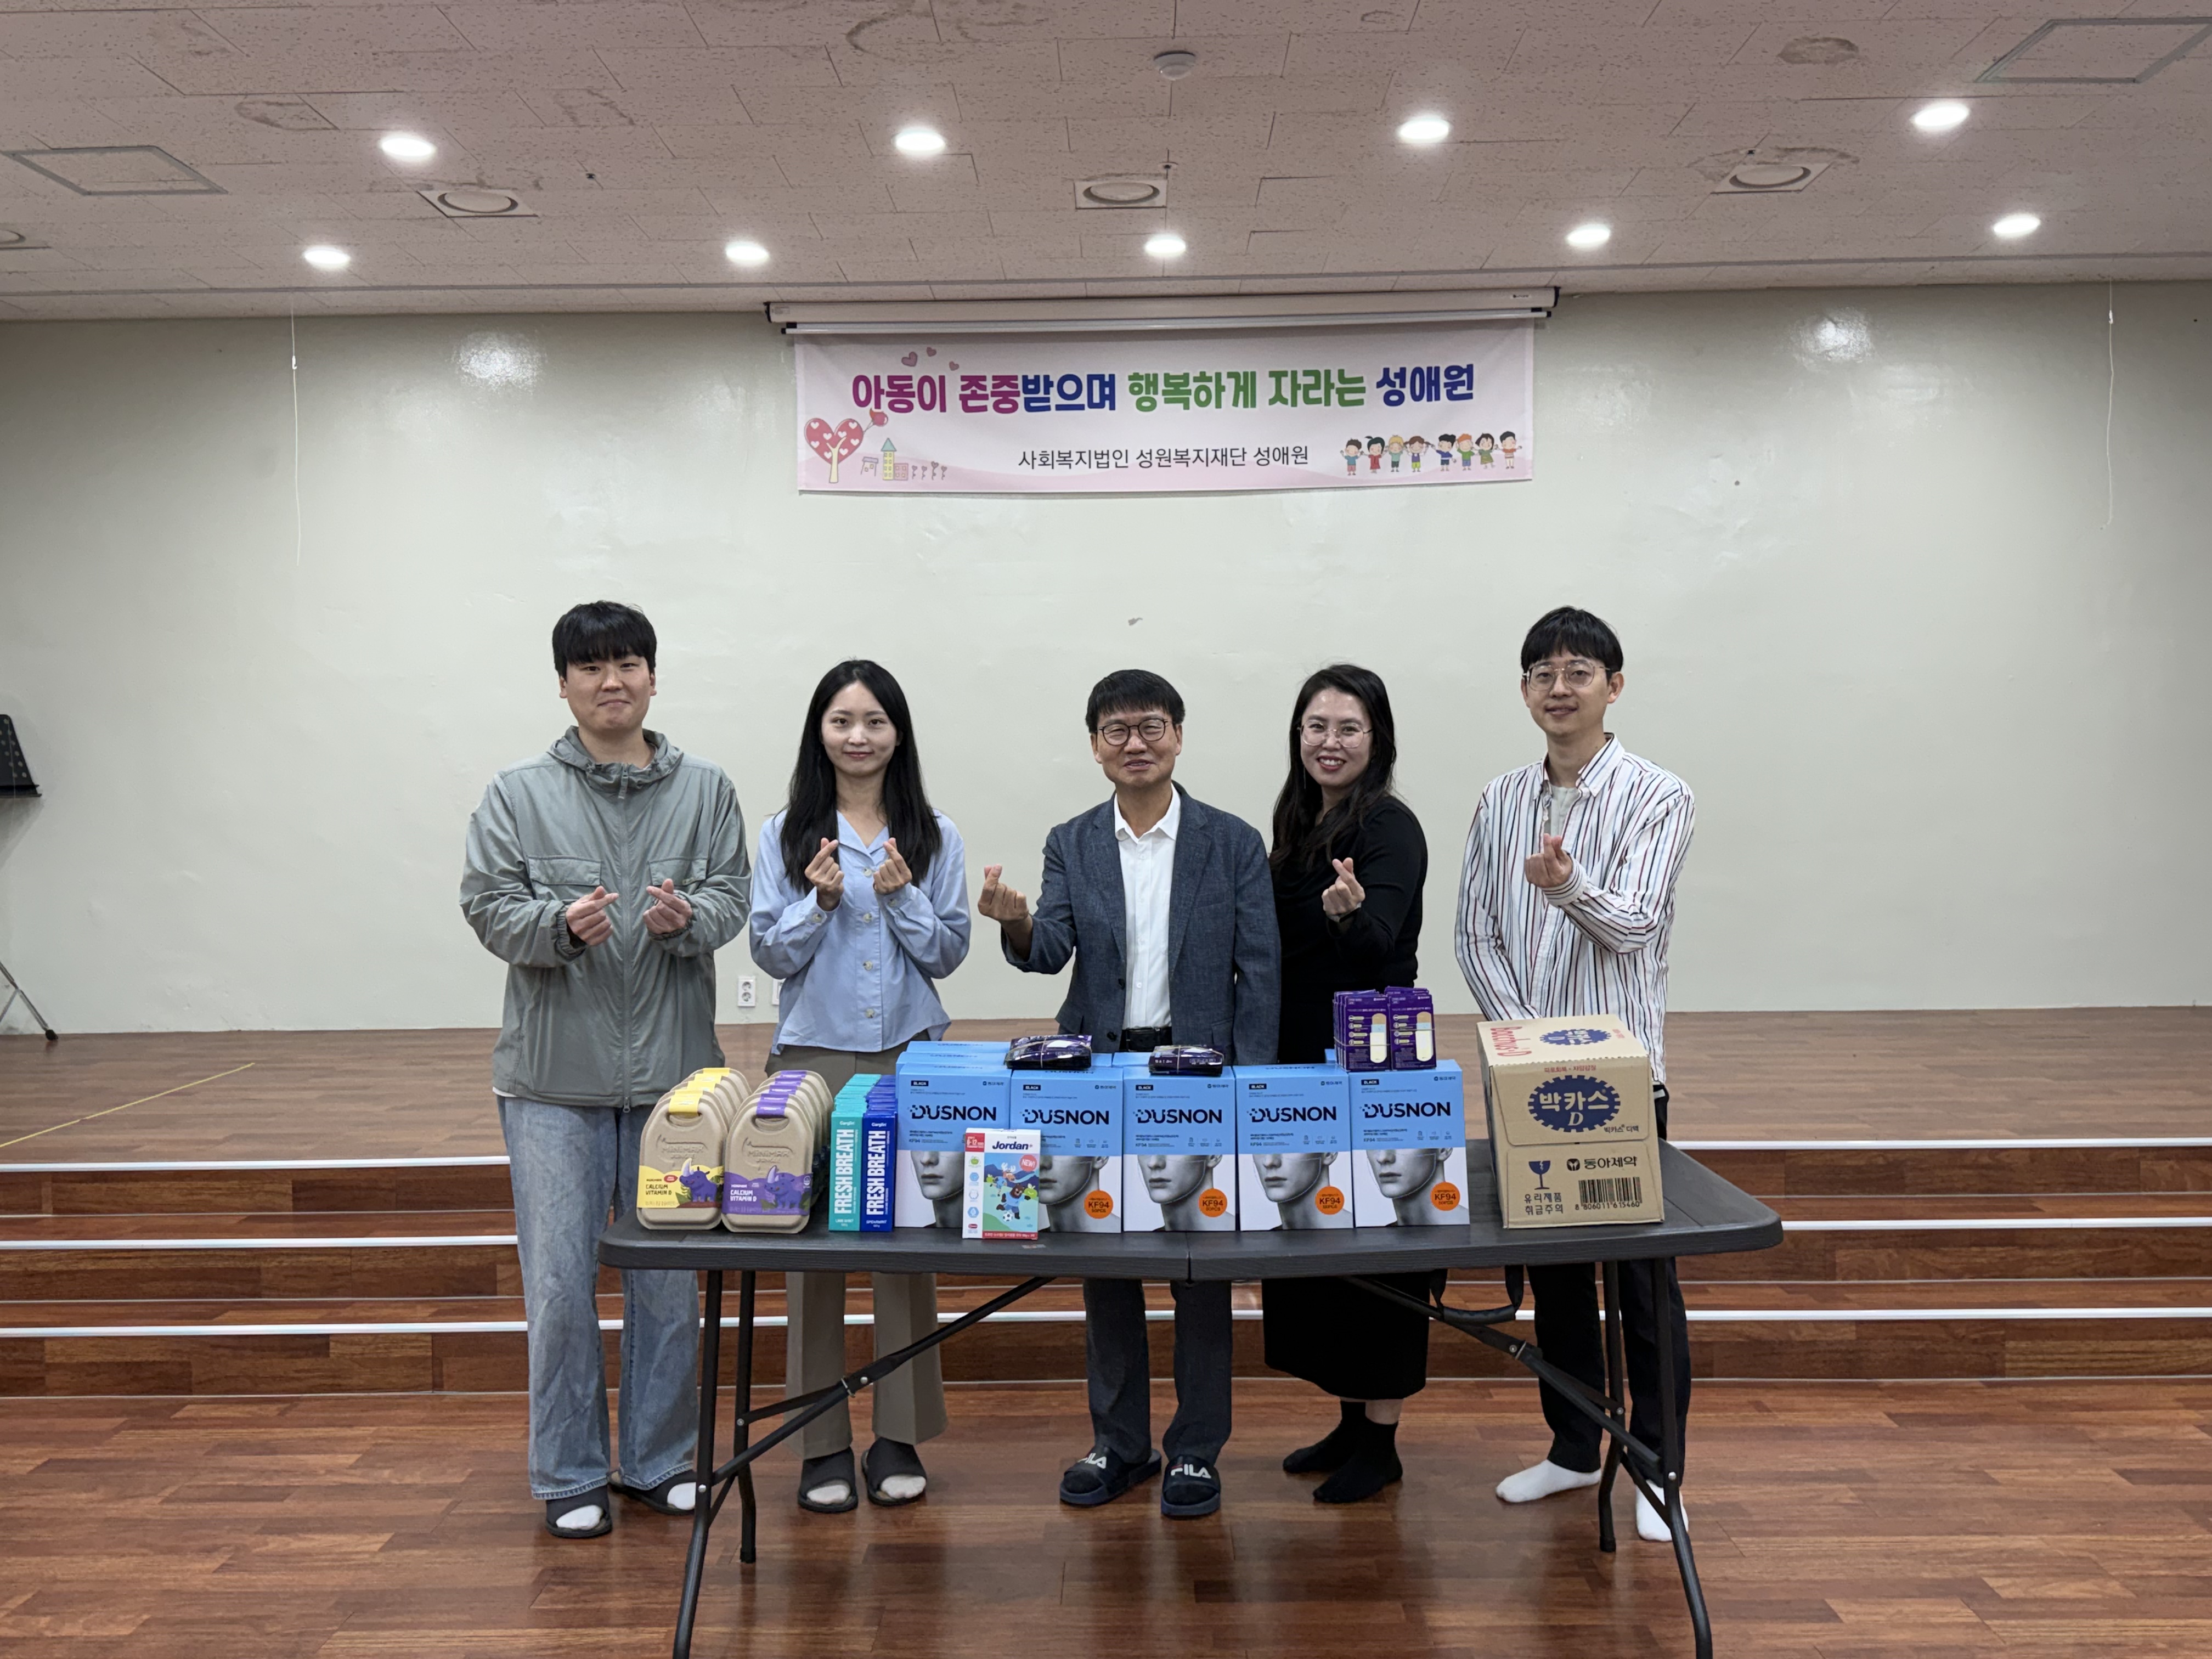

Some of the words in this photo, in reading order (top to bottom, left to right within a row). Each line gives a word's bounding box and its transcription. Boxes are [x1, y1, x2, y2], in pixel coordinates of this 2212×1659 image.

[852, 374, 947, 414] 아동이
[958, 373, 1116, 414] 존중받으며
[1128, 371, 1257, 413] 행복하게
[1268, 368, 1367, 408] 자라는
[1376, 364, 1474, 407] 성애원
[1018, 449, 1129, 470] 사회복지법인
[1136, 447, 1248, 468] 성원복지재단
[1253, 445, 1309, 466] 성애원
[1539, 1091, 1610, 1112] 박카스
[909, 1104, 997, 1121] DUSNON
[1022, 1109, 1109, 1125] DUSNON
[1135, 1109, 1222, 1124] DUSNON
[1248, 1106, 1337, 1122] DUSNON
[1362, 1102, 1451, 1119] DUSNON
[1567, 1111, 1584, 1126] D
[835, 1129, 854, 1175] BREATH
[867, 1130, 886, 1177] BREATH
[992, 1141, 1029, 1150] Jordan
[1021, 1159, 1035, 1167] NEW!
[1584, 1156, 1637, 1170] 동아제약
[834, 1176, 853, 1214] FRESH
[866, 1178, 885, 1215] FRESH
[1524, 1193, 1562, 1204] 유리제품
[1525, 1204, 1564, 1216] 취급주의
[1077, 1452, 1107, 1469] FILA
[1170, 1463, 1212, 1479] FILA
